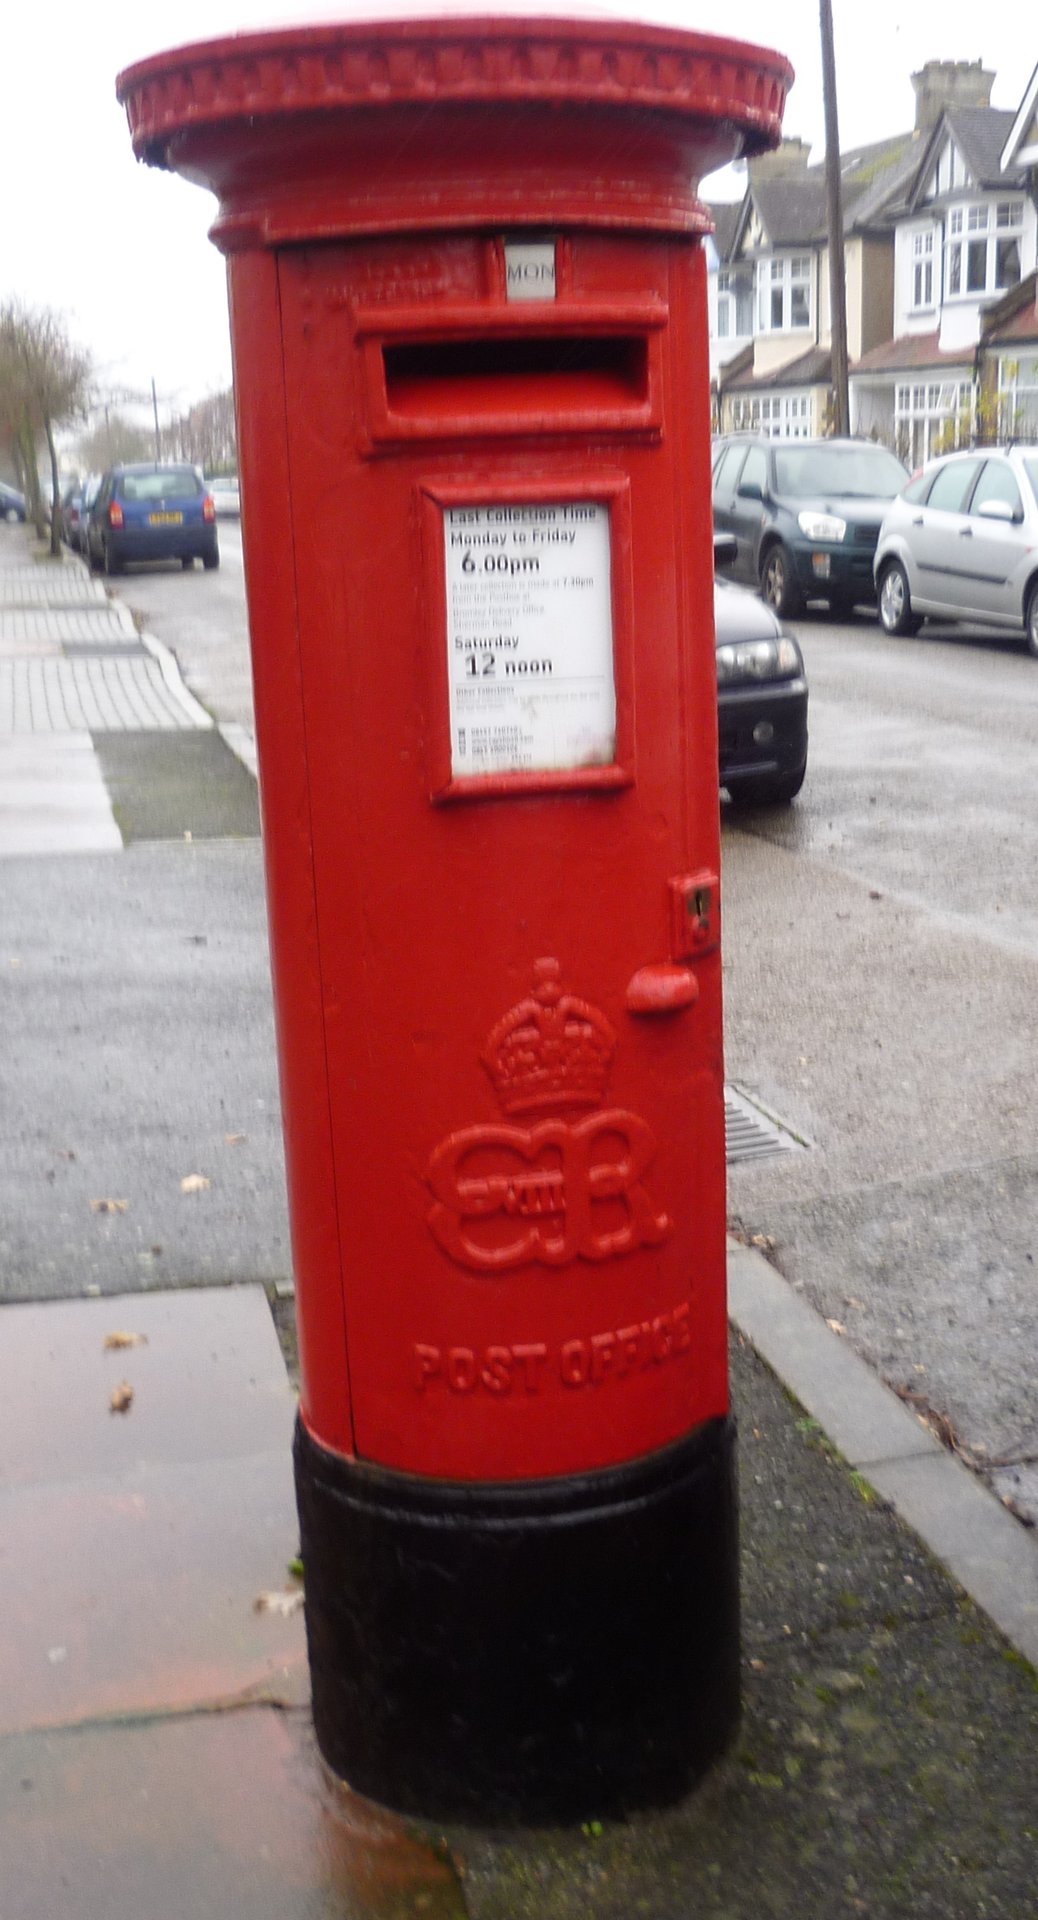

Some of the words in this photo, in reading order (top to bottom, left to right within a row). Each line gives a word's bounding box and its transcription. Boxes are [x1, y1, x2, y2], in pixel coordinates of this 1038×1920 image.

[507, 263, 555, 283] MON
[450, 507, 480, 524] Last
[486, 506, 557, 523] Collection
[562, 505, 597, 521] Time
[450, 531, 506, 547] Monday
[513, 530, 527, 543] to
[532, 528, 577, 547] Friday
[462, 550, 540, 575] 6.00pm
[455, 634, 519, 649] Saturday
[465, 654, 496, 677] 12
[505, 658, 553, 675] noon
[413, 1341, 546, 1396] POST
[560, 1303, 691, 1387] OFFICE
